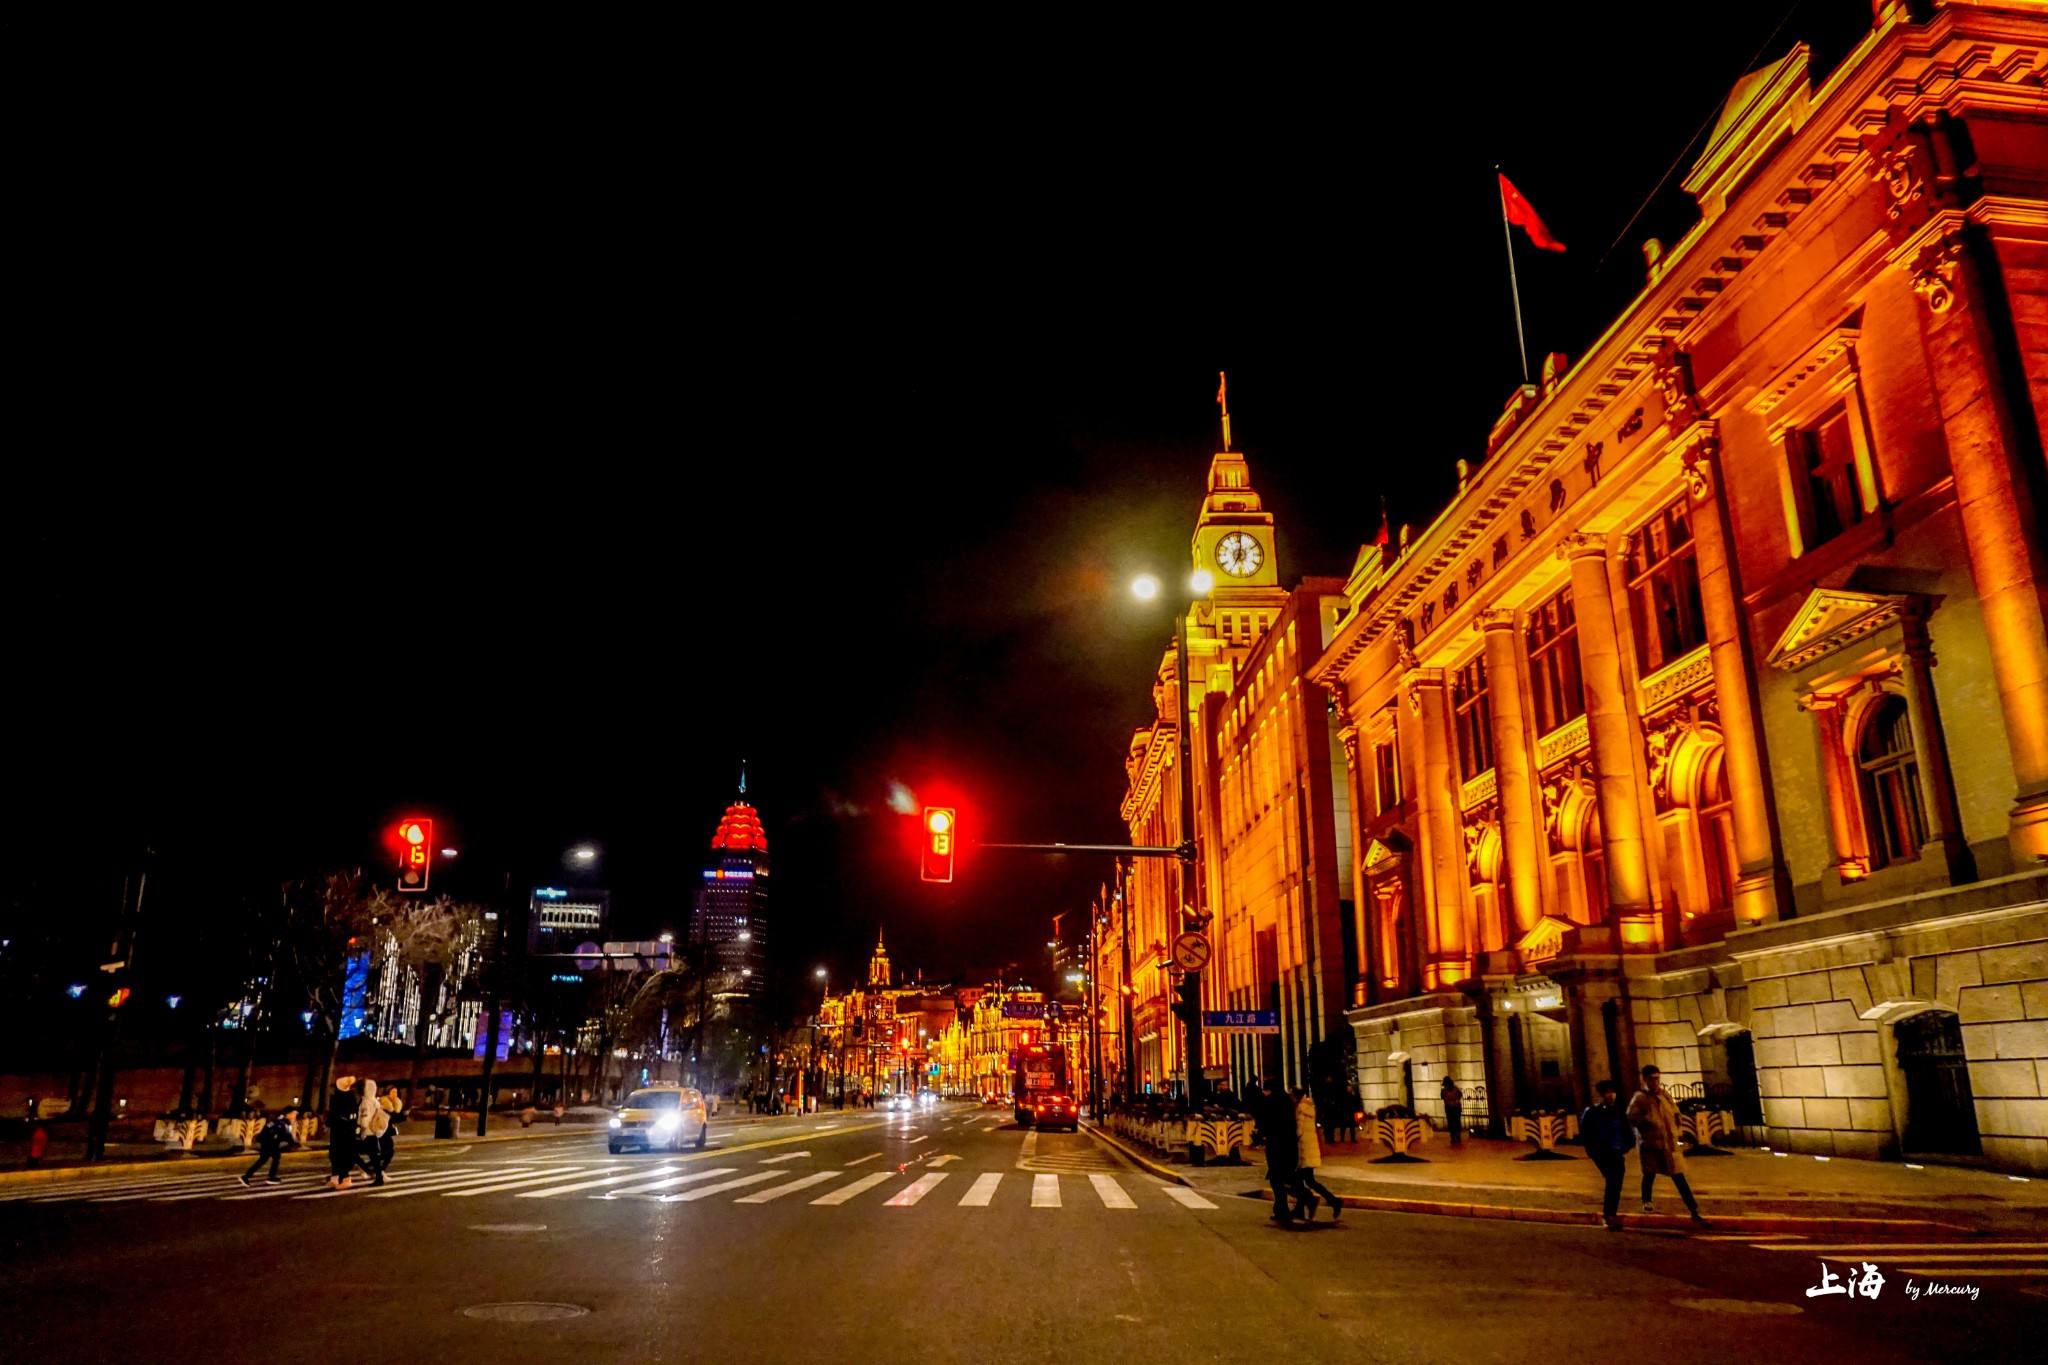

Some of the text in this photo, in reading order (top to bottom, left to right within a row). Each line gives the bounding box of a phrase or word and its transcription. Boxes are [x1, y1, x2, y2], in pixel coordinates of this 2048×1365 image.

[933, 834, 949, 854] 13
[1225, 1013, 1256, 1024] 九江路
